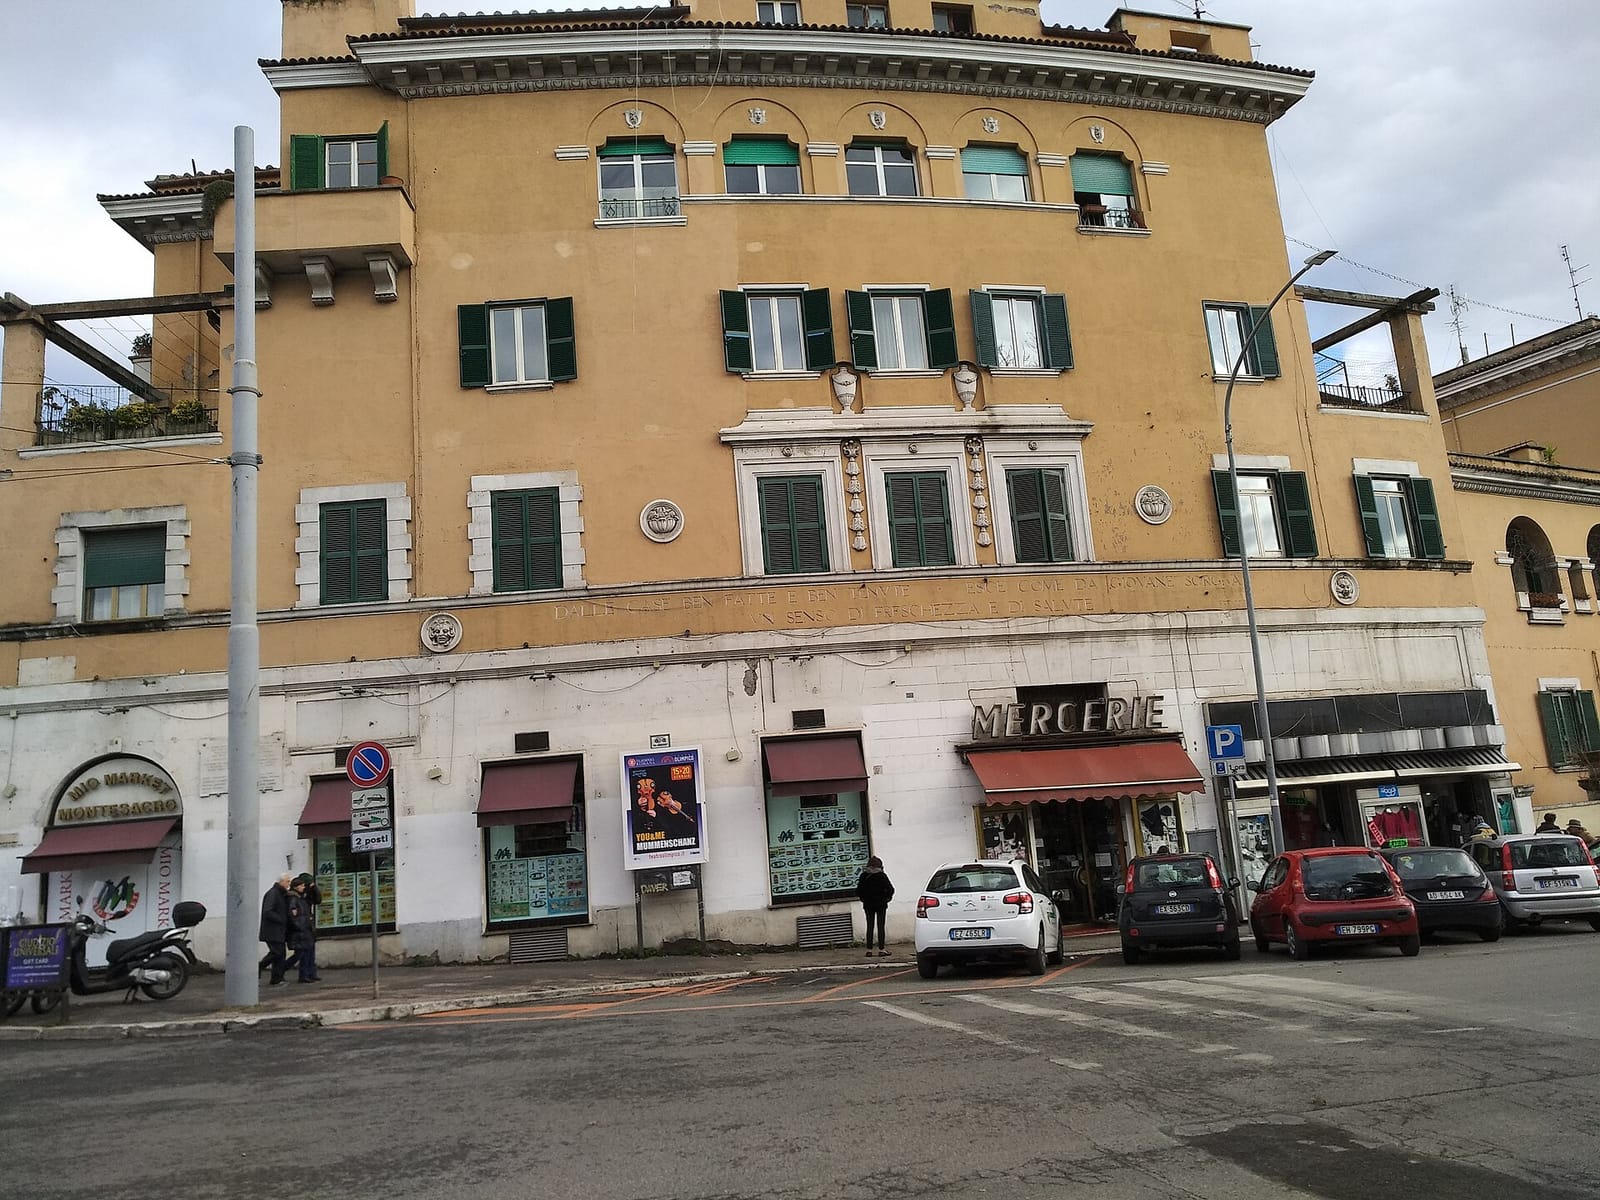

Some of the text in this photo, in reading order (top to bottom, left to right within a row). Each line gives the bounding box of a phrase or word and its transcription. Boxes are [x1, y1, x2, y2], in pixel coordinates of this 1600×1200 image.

[554, 600, 615, 620] DALLE
[682, 595, 713, 610] BEN
[723, 591, 777, 607] FATTE
[787, 590, 798, 604] E
[807, 588, 838, 602] BEN
[965, 581, 1006, 595] ESCE
[1017, 579, 1064, 593] COME
[1074, 578, 1097, 591] DA
[786, 609, 836, 624] SENSO
[848, 607, 864, 621] DI
[875, 602, 980, 618] FRESCHEZZA
[989, 601, 999, 614] E
[1008, 600, 1024, 613] DI
[972, 695, 1166, 740] MERCERIE
[1215, 729, 1235, 755] P
[67, 772, 173, 801] MIO MARKET
[57, 799, 177, 821] MONTESACRO
[355, 835, 387, 846] 2 posti
[636, 837, 696, 851] MUMMENSCHANZ
[160, 847, 172, 877] MIO
